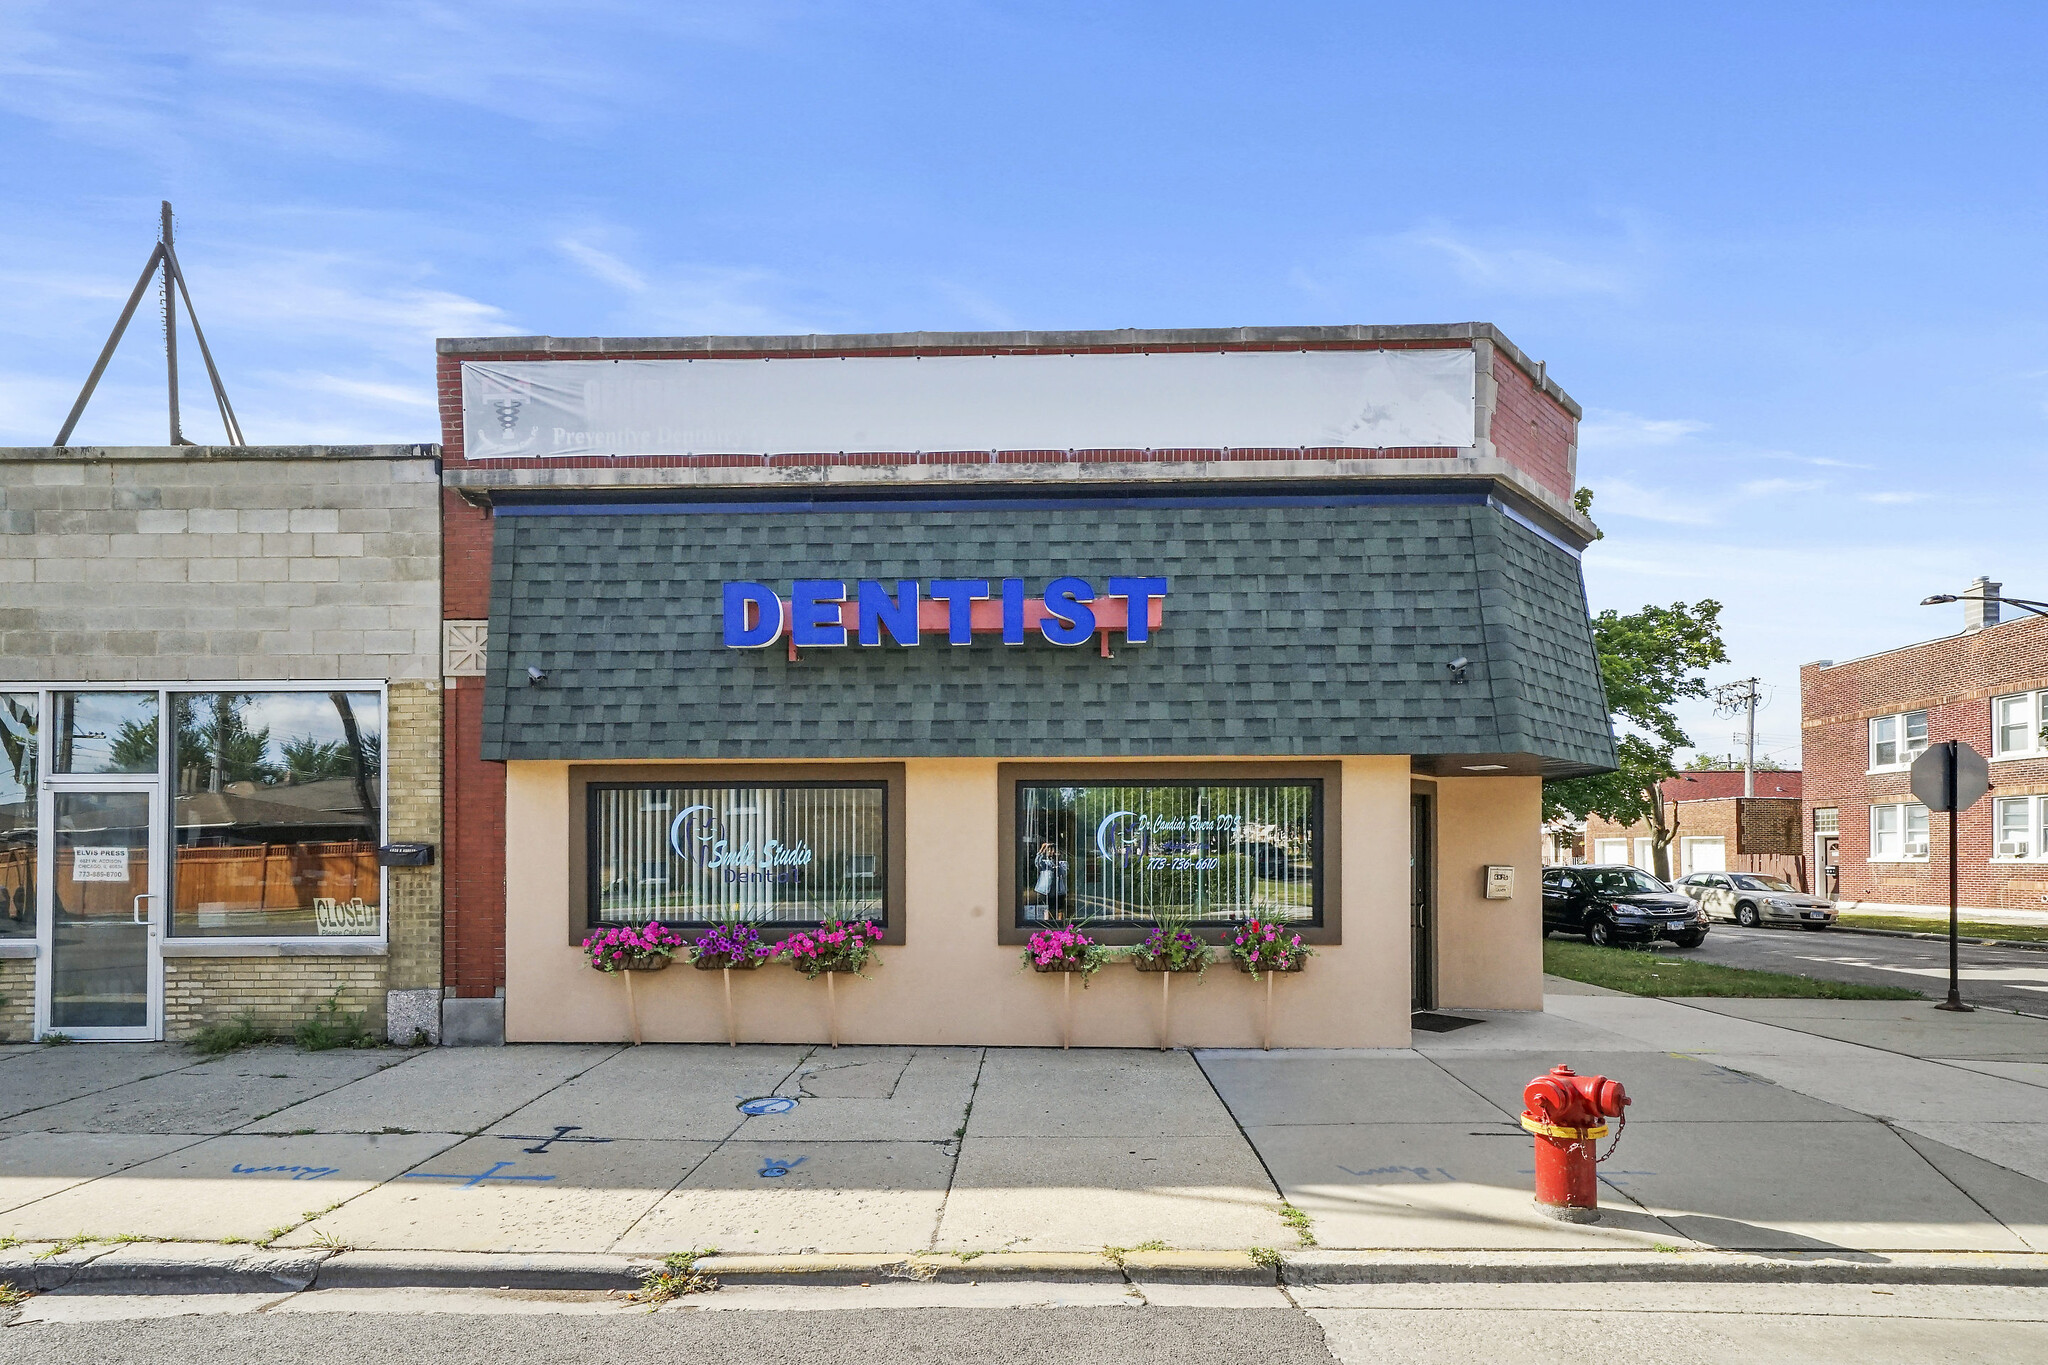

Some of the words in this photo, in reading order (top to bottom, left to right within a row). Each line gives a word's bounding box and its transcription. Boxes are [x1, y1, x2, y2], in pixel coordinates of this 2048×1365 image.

[723, 576, 1167, 648] DENTIST
[1153, 813, 1186, 834] Candido
[1216, 814, 1241, 832] DDS
[708, 840, 755, 868] Smile
[760, 839, 812, 869] Studio
[1146, 857, 1218, 871] 773-736-6610
[724, 868, 801, 884] Dental
[317, 899, 374, 927] CLOSED
[321, 928, 342, 936] Please
[343, 928, 357, 936] Call
